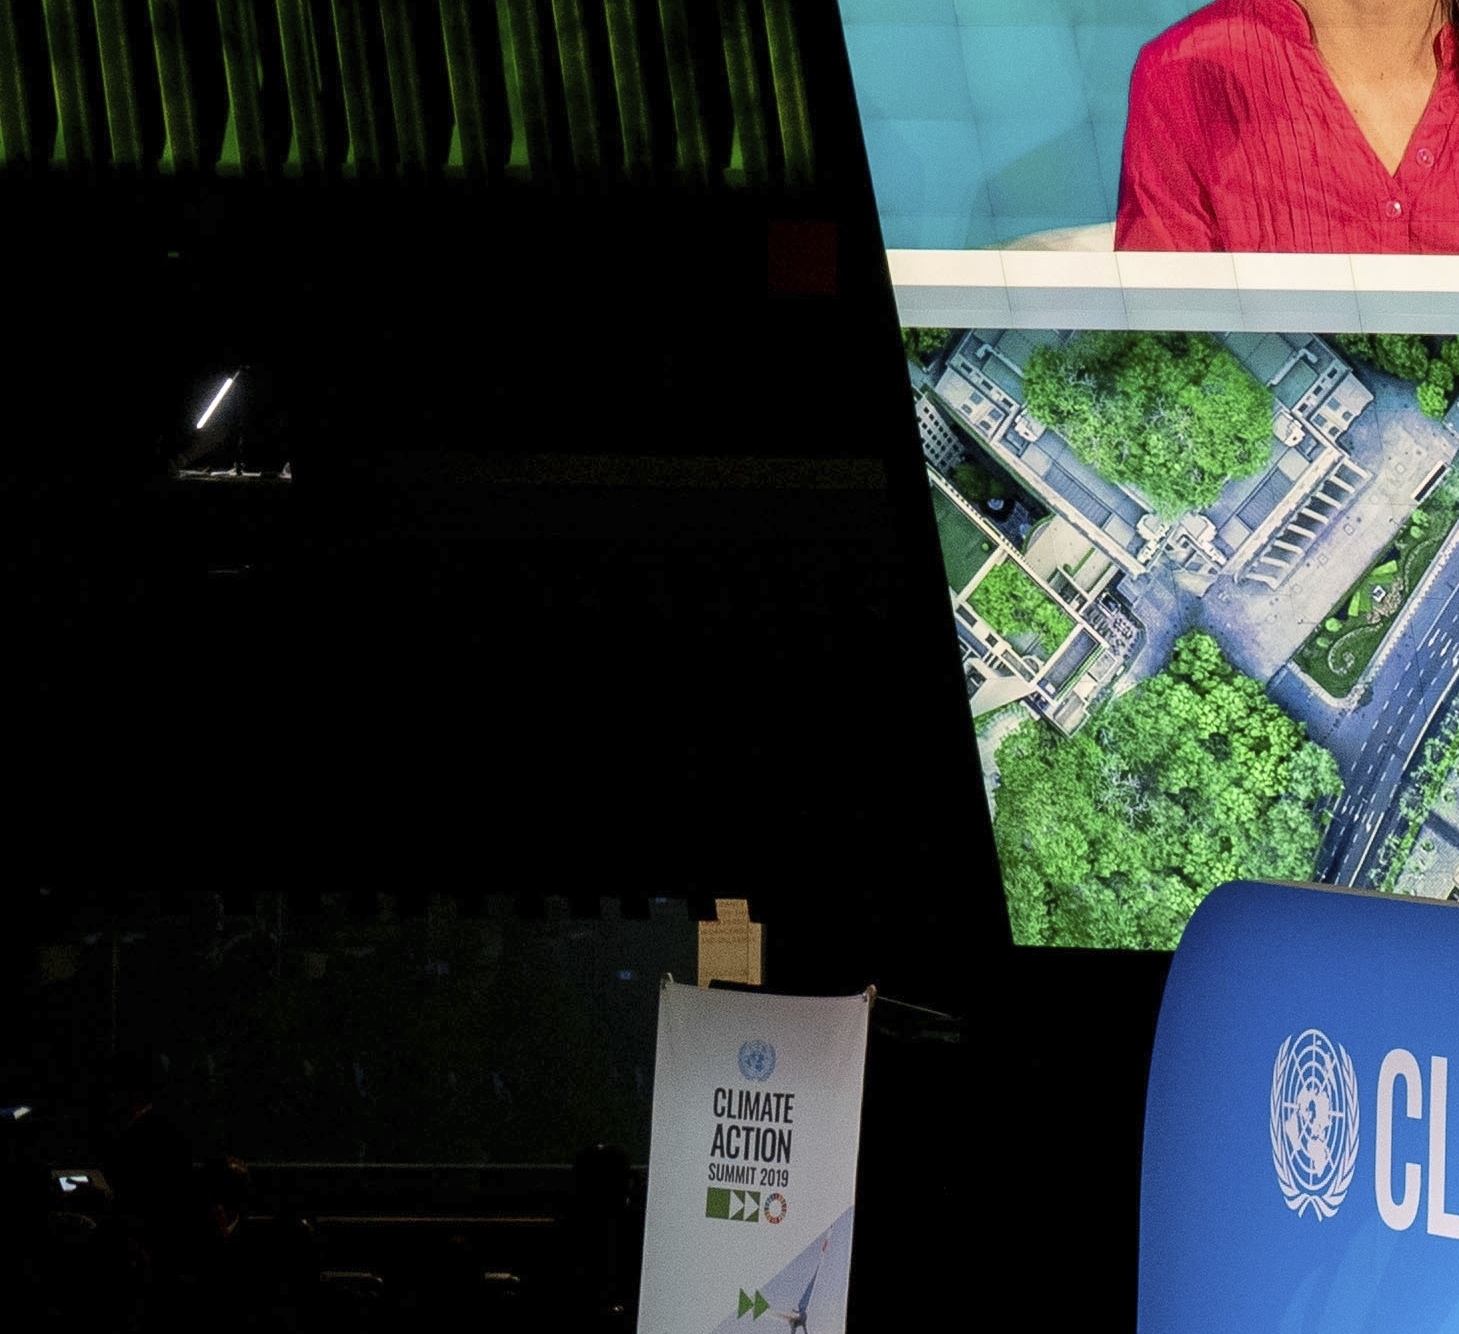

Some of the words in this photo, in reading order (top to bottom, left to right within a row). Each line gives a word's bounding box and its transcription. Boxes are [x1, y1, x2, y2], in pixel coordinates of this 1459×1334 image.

[713, 1087, 795, 1124] CLIMATE
[710, 1123, 792, 1164] ACTION
[708, 1162, 757, 1185] SUMMIT
[760, 1168, 789, 1187] 2019
